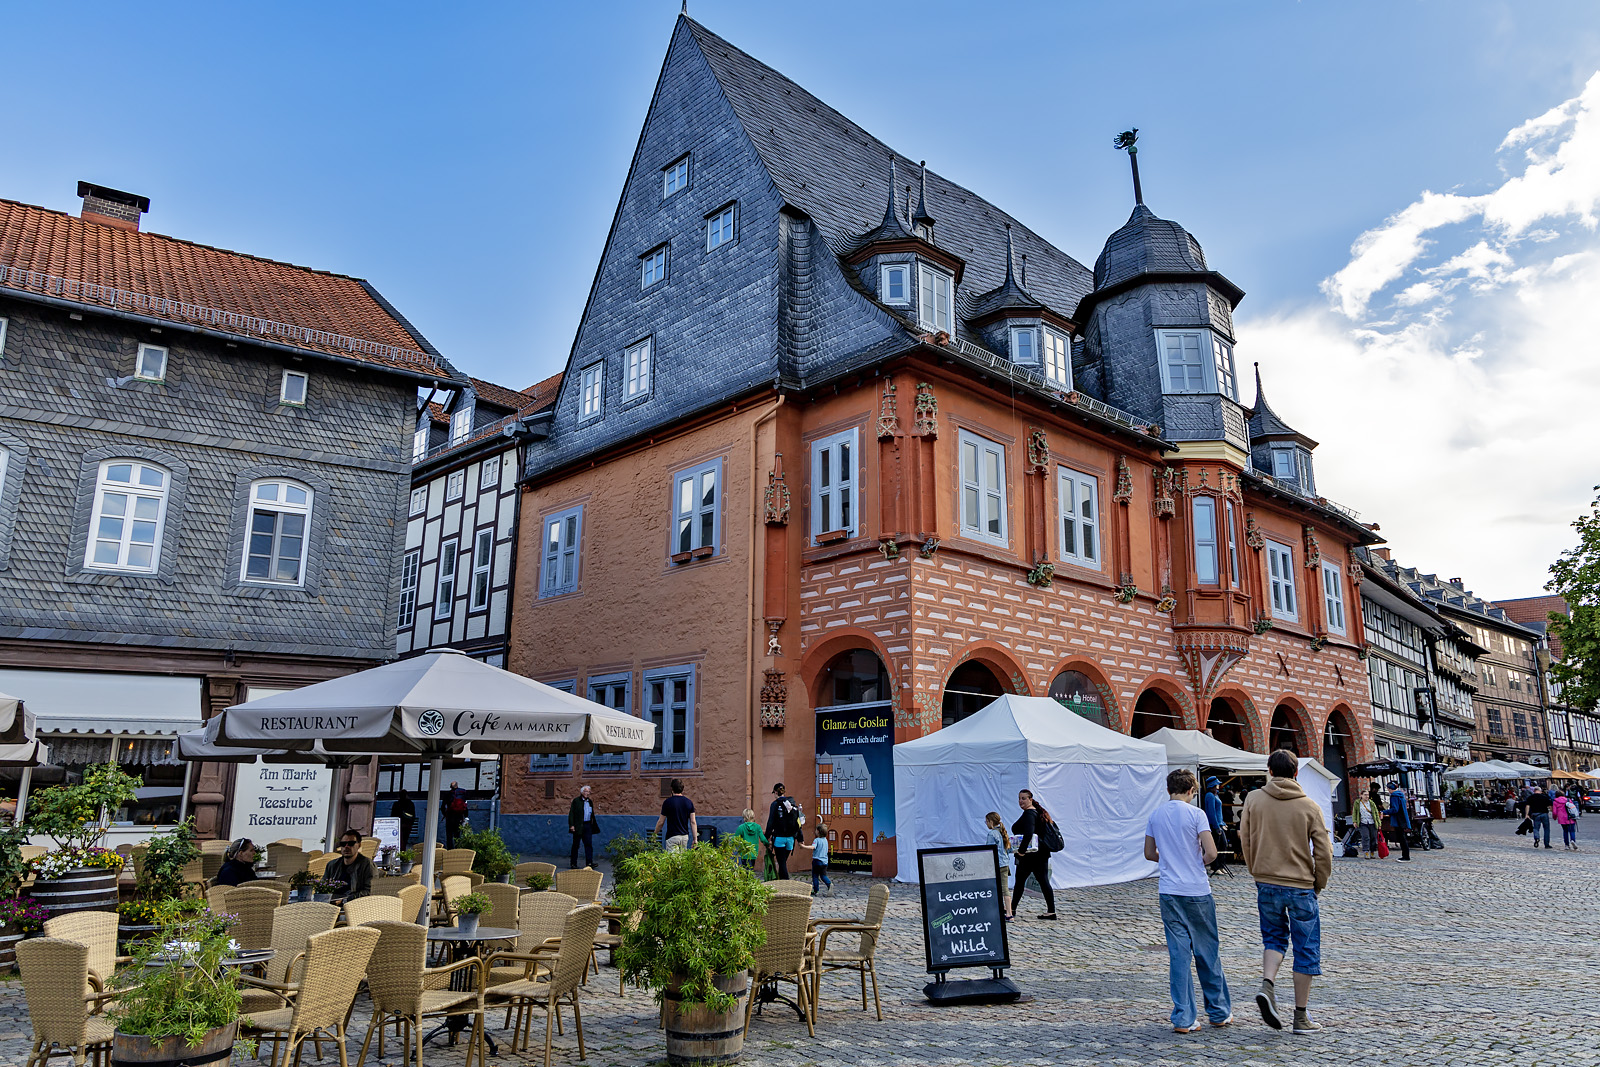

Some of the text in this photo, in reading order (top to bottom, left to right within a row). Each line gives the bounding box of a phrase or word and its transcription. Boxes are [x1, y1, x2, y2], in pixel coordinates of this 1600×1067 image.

[1082, 694, 1098, 703] Hotel
[260, 716, 359, 730] RESTAURANT
[452, 710, 571, 737] Café AM MARKT
[822, 716, 889, 731] Glanz für Goslar
[606, 724, 644, 741] RESTAURANT
[856, 735, 869, 744] dich
[259, 768, 317, 780] Am Markt
[258, 796, 313, 809] Teestube
[248, 813, 318, 826] Restaurant
[830, 857, 850, 866] Sanierung
[938, 889, 992, 902] Leckeres
[952, 906, 978, 916] vom
[942, 921, 992, 936] Harzer
[951, 937, 988, 954] Wild
